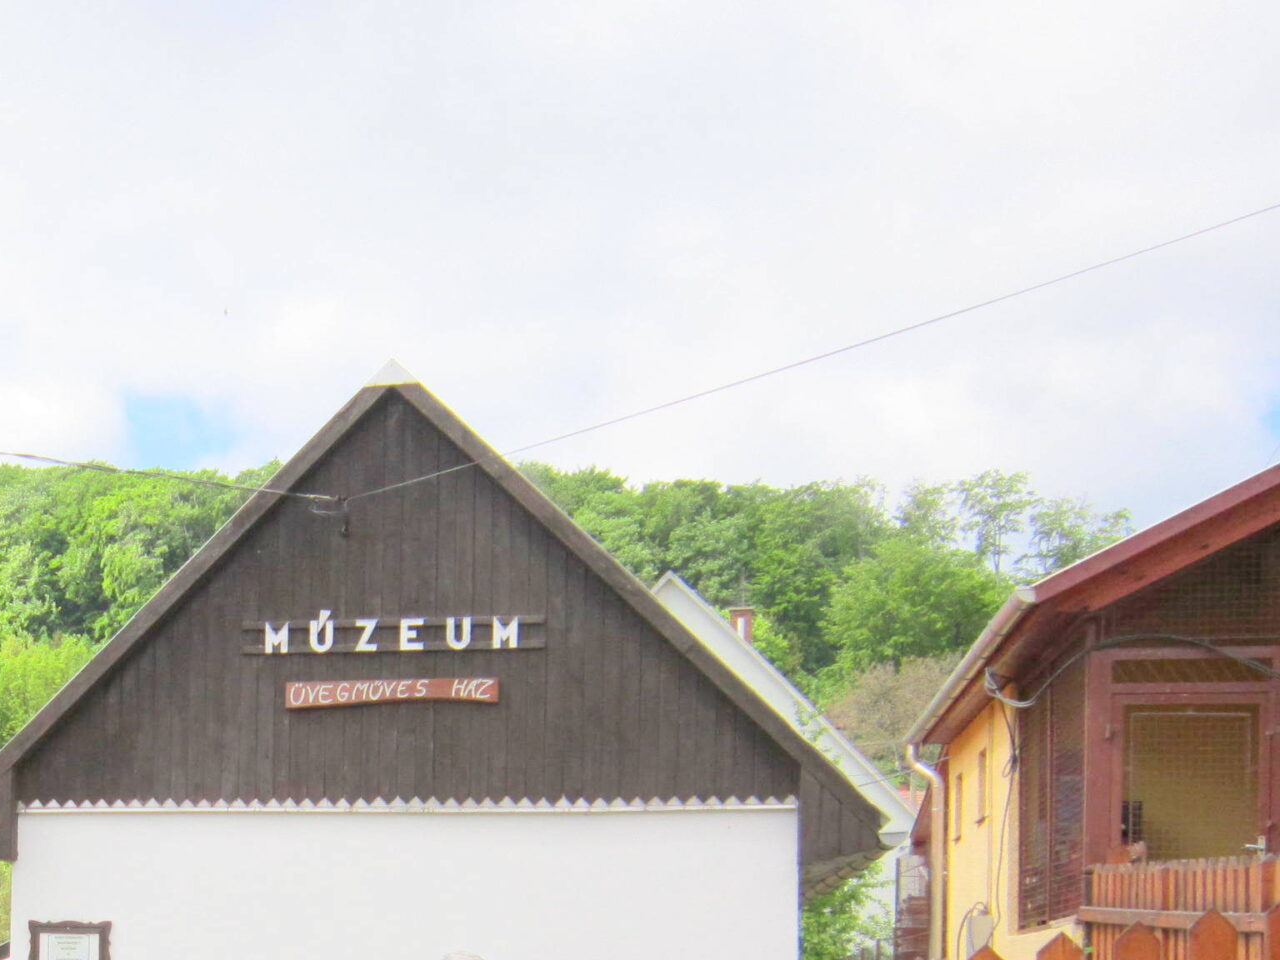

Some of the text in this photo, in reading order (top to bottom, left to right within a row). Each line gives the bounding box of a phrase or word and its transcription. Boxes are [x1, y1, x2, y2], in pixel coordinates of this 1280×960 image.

[264, 609, 519, 654] MÚZEUM
[289, 678, 495, 706] ÜVEGMŰVES HÁZ
